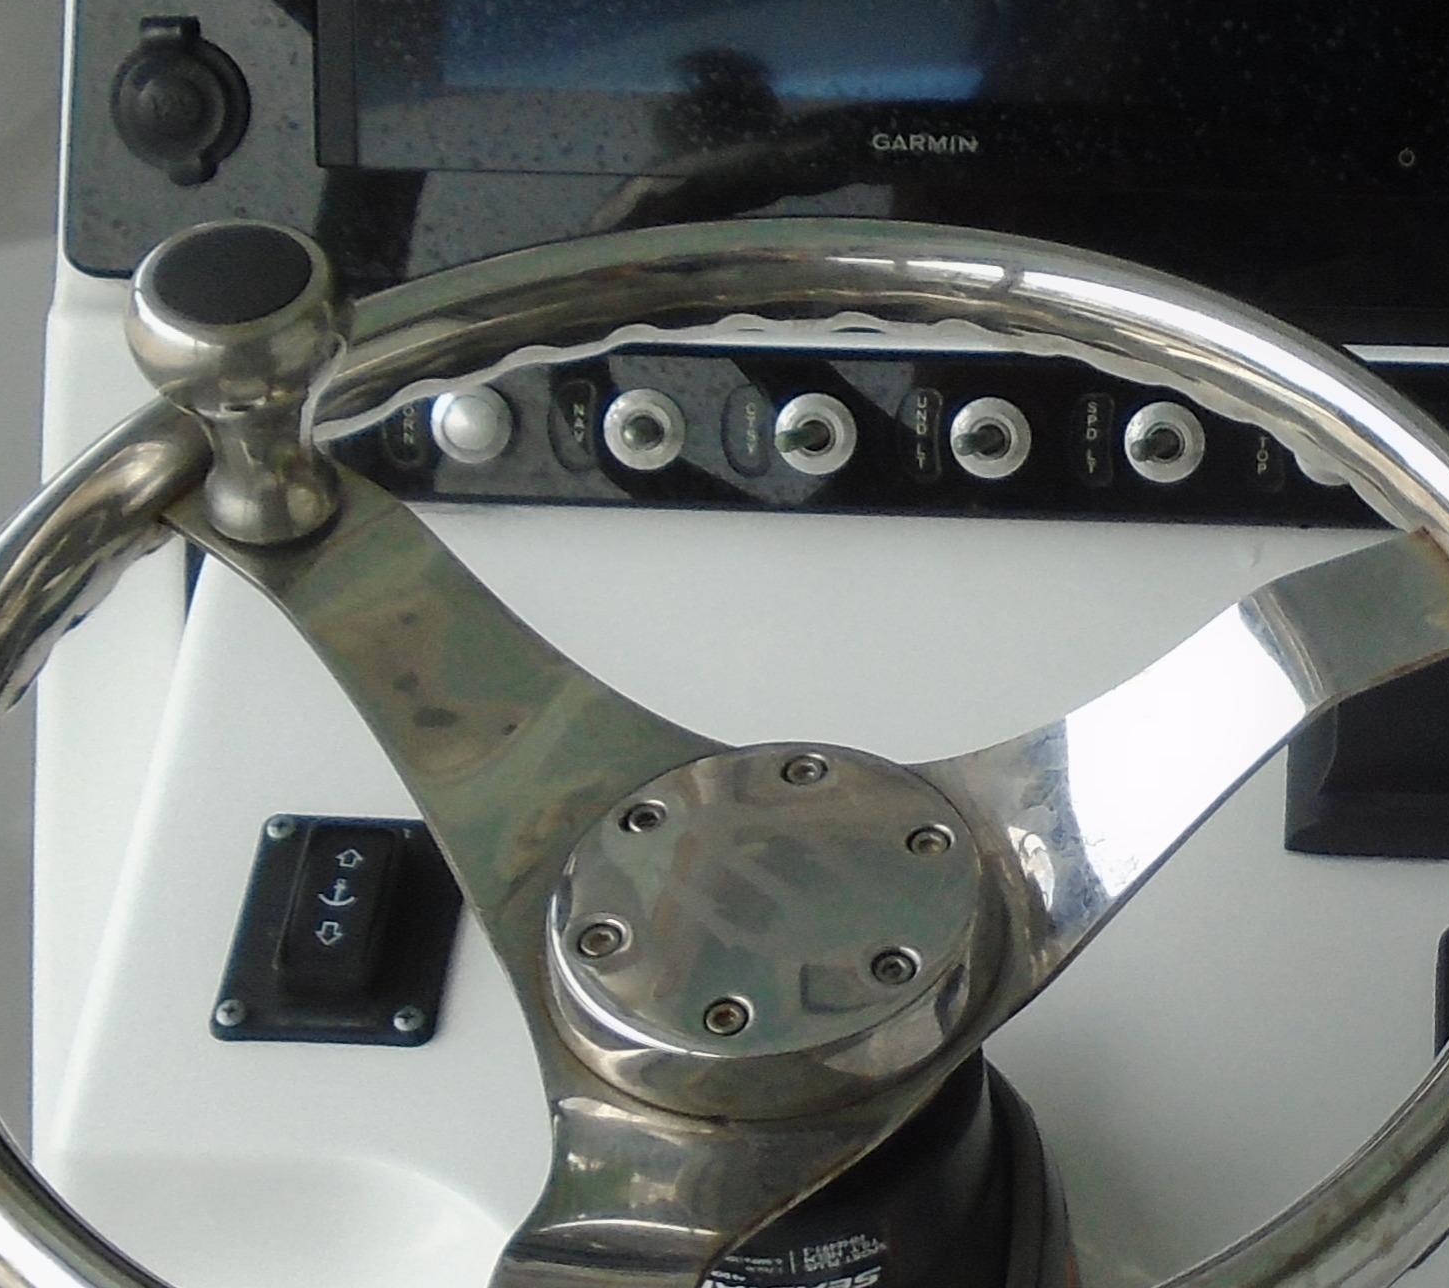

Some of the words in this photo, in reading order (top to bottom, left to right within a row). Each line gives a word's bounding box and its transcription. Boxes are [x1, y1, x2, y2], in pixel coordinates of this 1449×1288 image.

[872, 132, 979, 153] GARMIN
[402, 406, 415, 445] ORN
[572, 404, 585, 444] NAV
[916, 395, 928, 435] UND
[1086, 401, 1098, 440] SPD
[916, 442, 928, 469] LT
[1085, 449, 1096, 474] LT
